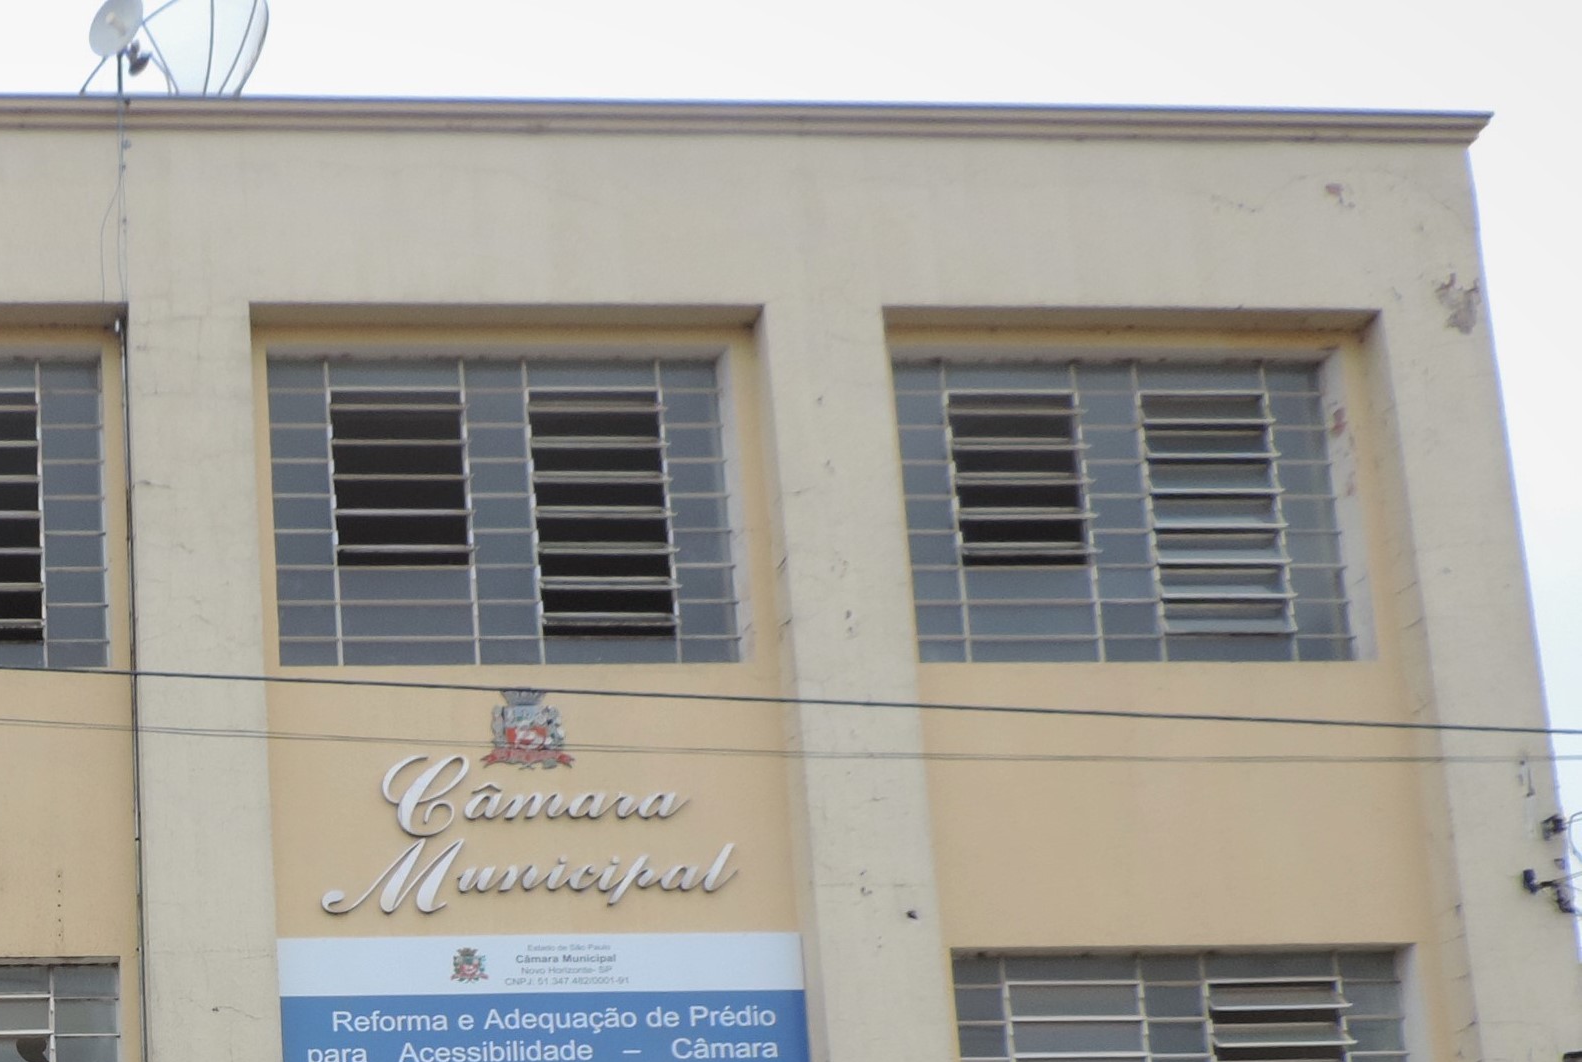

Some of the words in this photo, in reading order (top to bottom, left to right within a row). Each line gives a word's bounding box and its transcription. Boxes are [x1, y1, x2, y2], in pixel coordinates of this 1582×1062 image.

[381, 754, 690, 837] Câmara
[321, 838, 737, 915] Municipal
[588, 943, 611, 951] Paulo
[515, 953, 559, 964] Câmara
[562, 953, 617, 964] Municipal
[521, 967, 546, 975] Novo
[598, 965, 613, 973] SP
[332, 1010, 449, 1033] Reforma
[458, 1013, 475, 1031] e
[483, 1007, 638, 1034] Adequação
[646, 1006, 680, 1028] de
[690, 1005, 777, 1028] Prédio
[671, 1037, 779, 1059] Câmara
